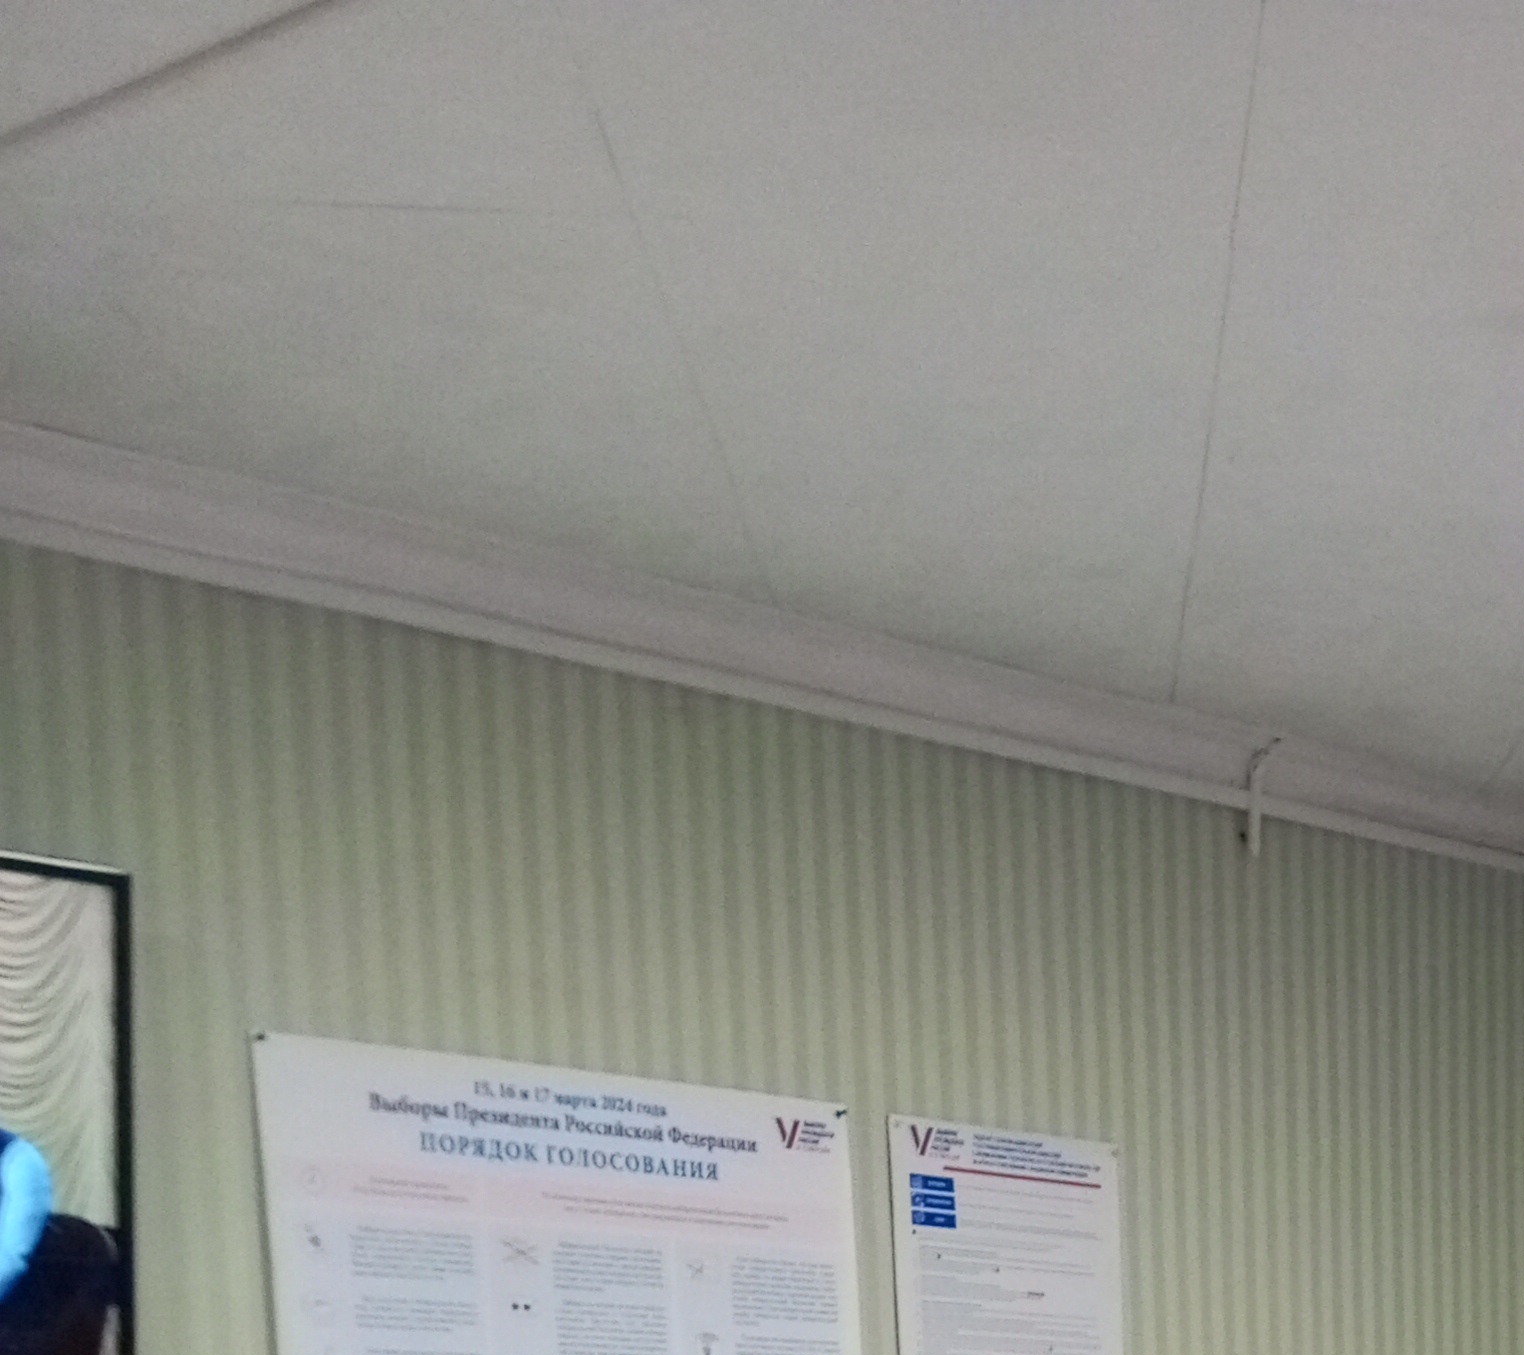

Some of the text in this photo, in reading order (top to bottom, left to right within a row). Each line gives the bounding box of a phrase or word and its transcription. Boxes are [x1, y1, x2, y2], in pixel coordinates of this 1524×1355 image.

[368, 1090, 757, 1153] Выборы Президента Российской Федерации
[555, 1092, 597, 1110] марта
[602, 1095, 633, 1113] 2024
[637, 1102, 668, 1117] года
[420, 1130, 719, 1181] ПОРЯДОК ГОЛОСОВАНИЯ
